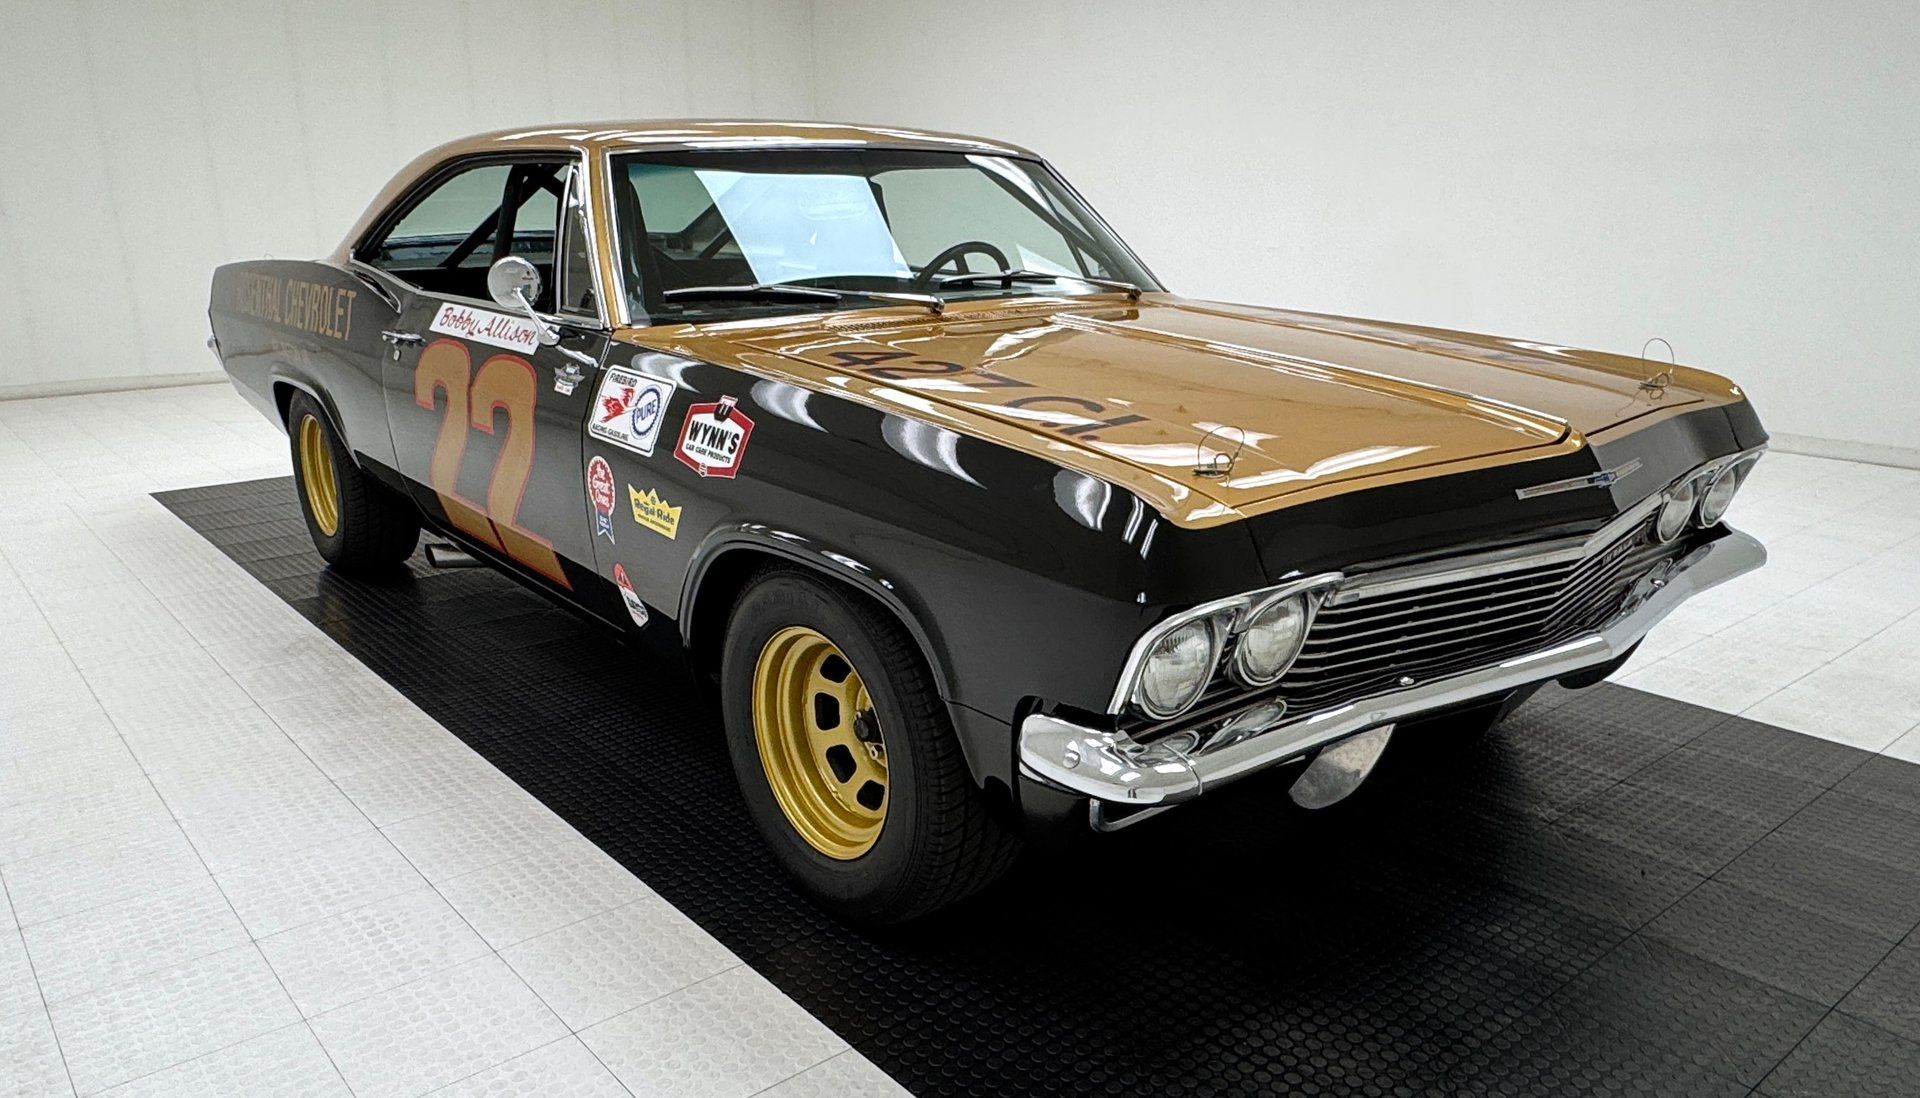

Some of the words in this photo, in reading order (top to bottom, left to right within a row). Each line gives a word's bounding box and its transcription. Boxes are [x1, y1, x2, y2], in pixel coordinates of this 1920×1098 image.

[284, 278, 357, 341] CHEVROLET
[439, 307, 480, 338] Bobby
[477, 315, 537, 346] Allison
[828, 351, 1038, 389] 427
[635, 399, 657, 425] PURE
[685, 443, 695, 451] CAR
[707, 450, 731, 464] PRODUCTS
[688, 420, 740, 455] WYNN'S
[414, 338, 573, 591] 22
[633, 498, 656, 516] Regal
[656, 508, 675, 526] Ride
